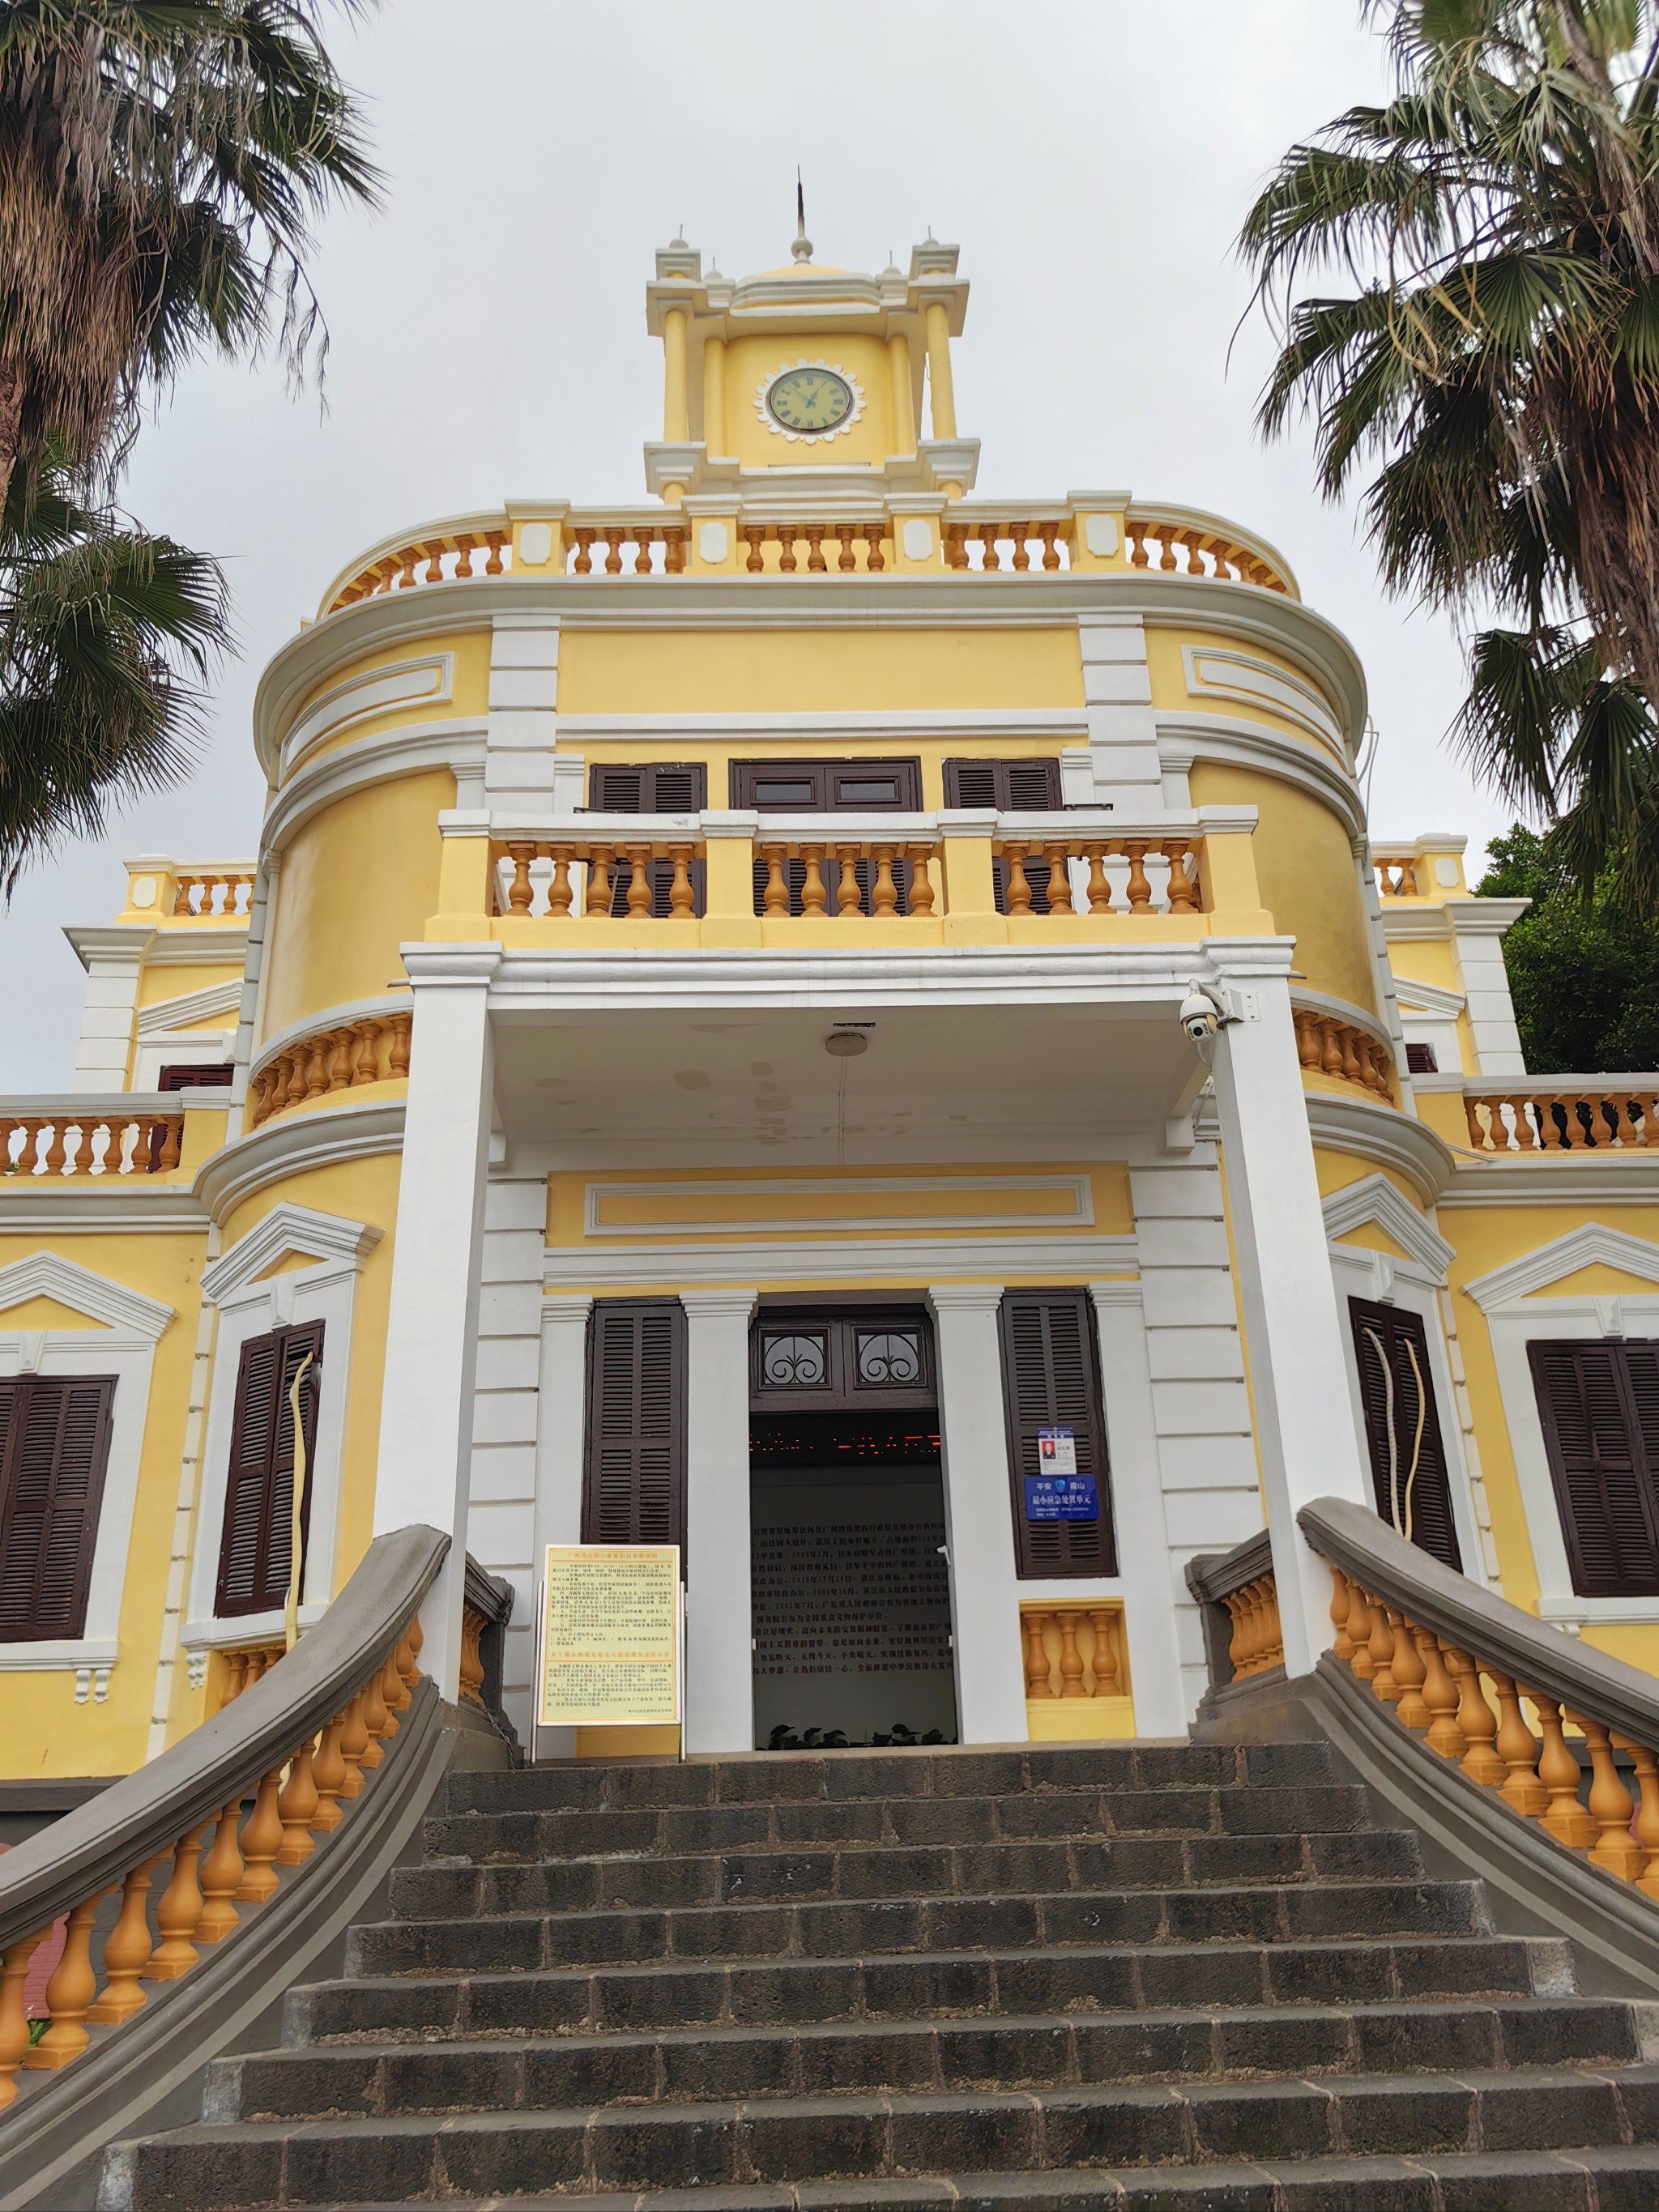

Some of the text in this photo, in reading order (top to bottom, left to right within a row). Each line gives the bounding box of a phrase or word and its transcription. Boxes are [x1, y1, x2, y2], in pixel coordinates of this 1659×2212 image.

[1037, 1482, 1051, 1490] 平安
[1032, 1494, 1092, 1505] 最小应急处置单元
